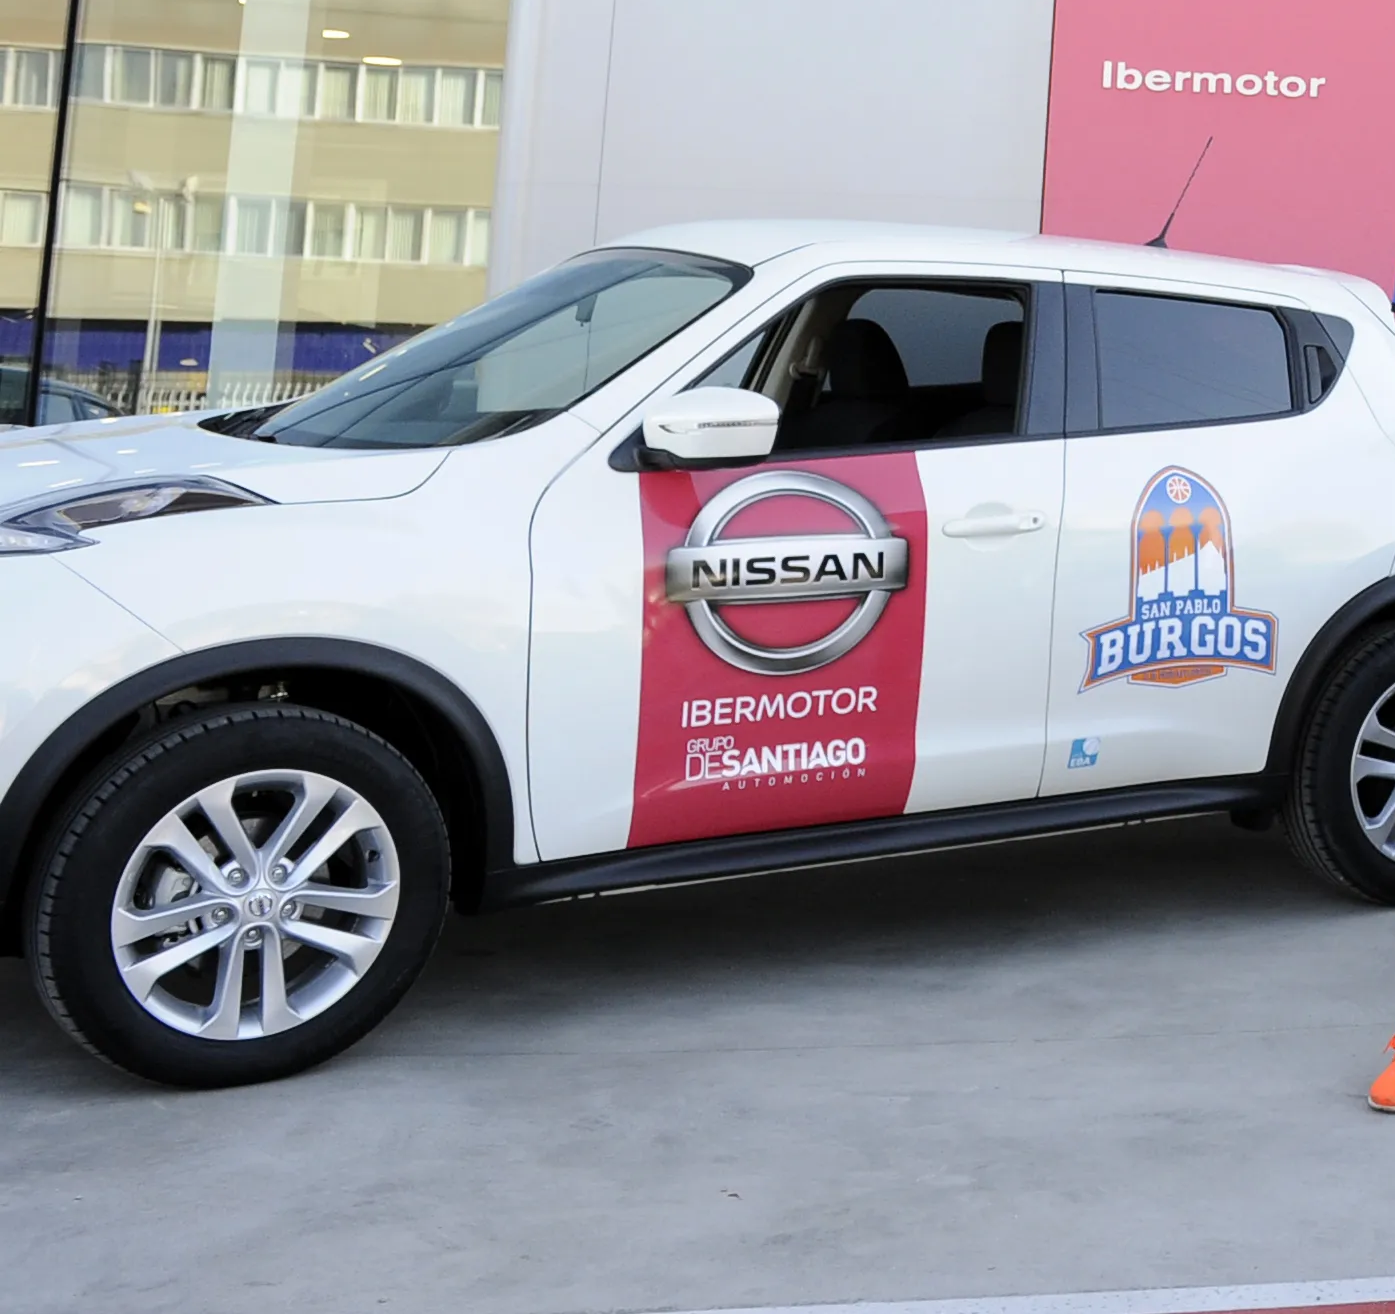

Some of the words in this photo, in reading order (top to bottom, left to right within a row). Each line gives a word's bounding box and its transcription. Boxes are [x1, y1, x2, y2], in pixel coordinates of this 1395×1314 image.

[1102, 60, 1327, 98] Ibermotor
[692, 551, 885, 588] NISSAN
[1141, 600, 1172, 619] SAN
[1175, 598, 1221, 616] PABLO
[1096, 615, 1268, 676] BURGOS
[681, 685, 878, 728] IBERMOTOR
[686, 735, 735, 754] GRUPO
[721, 767, 867, 791] AUTOMOCIÓN
